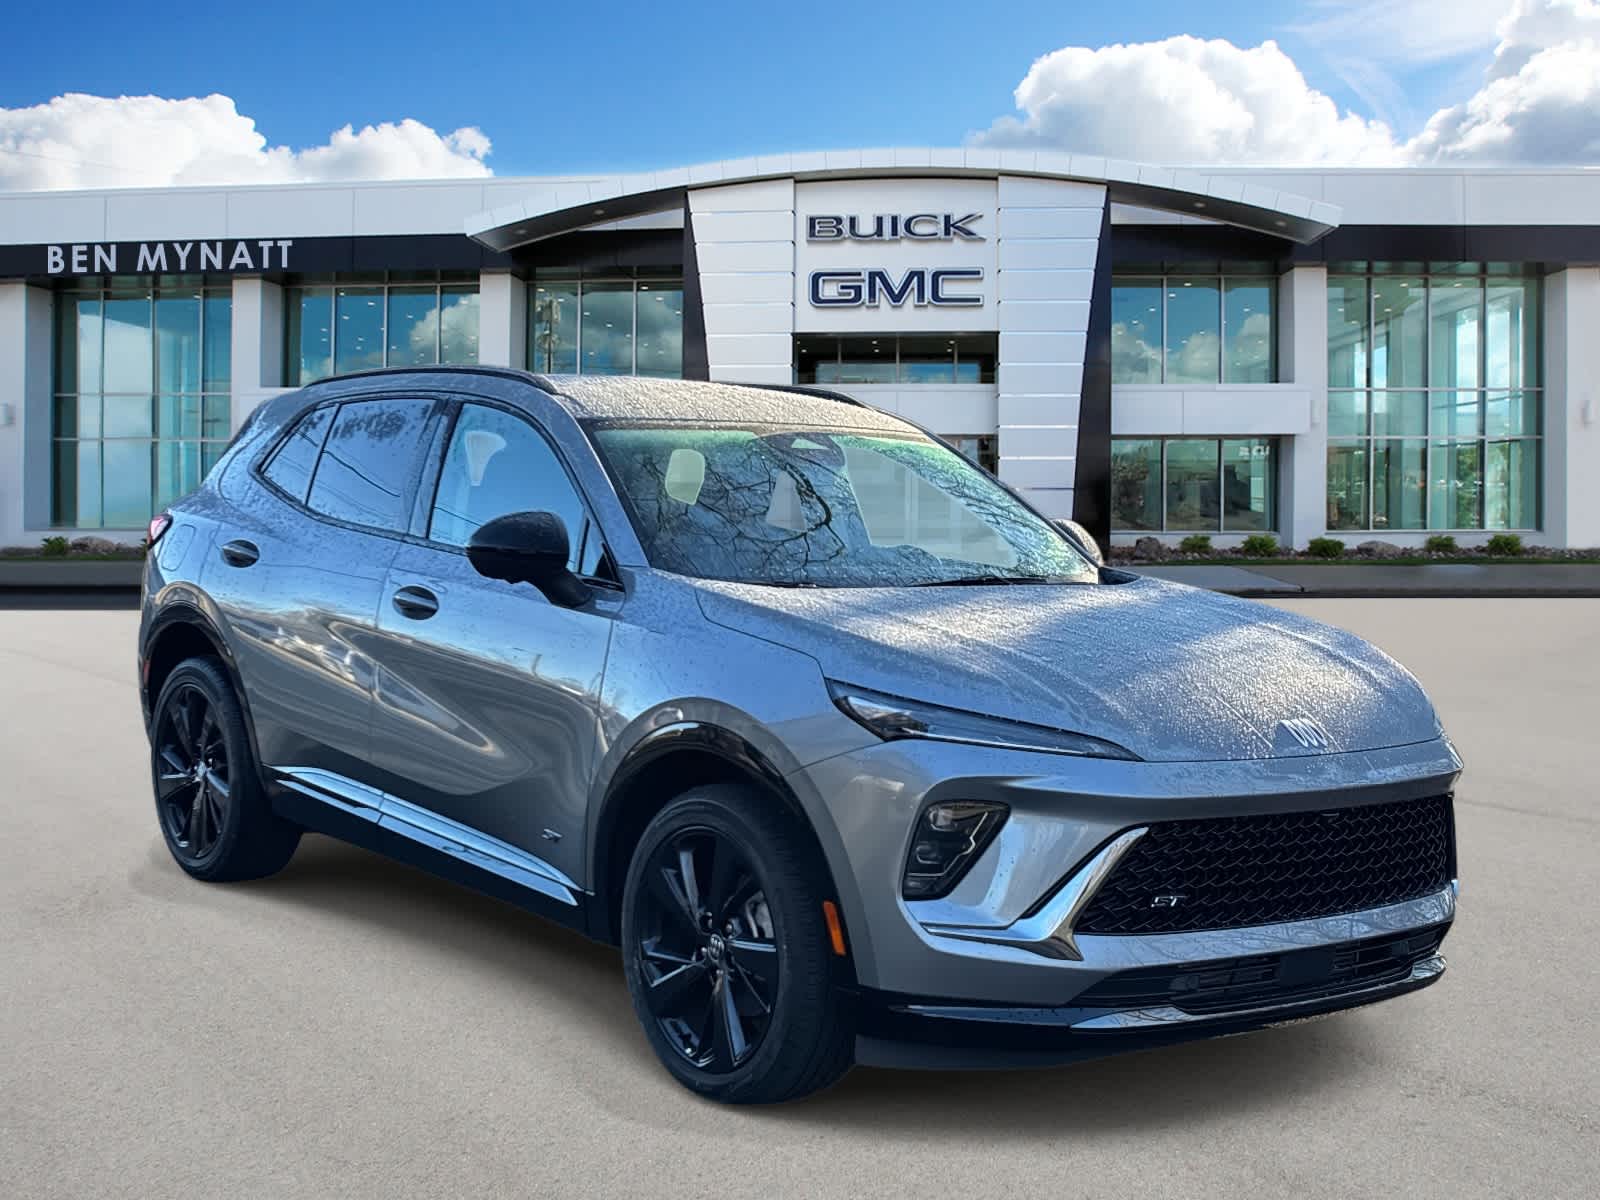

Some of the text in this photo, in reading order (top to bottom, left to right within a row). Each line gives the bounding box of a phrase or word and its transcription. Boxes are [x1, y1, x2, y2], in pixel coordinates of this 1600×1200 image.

[807, 214, 986, 242] BUICK
[47, 240, 293, 274] BEN MYNATT
[809, 267, 984, 307] GMC
